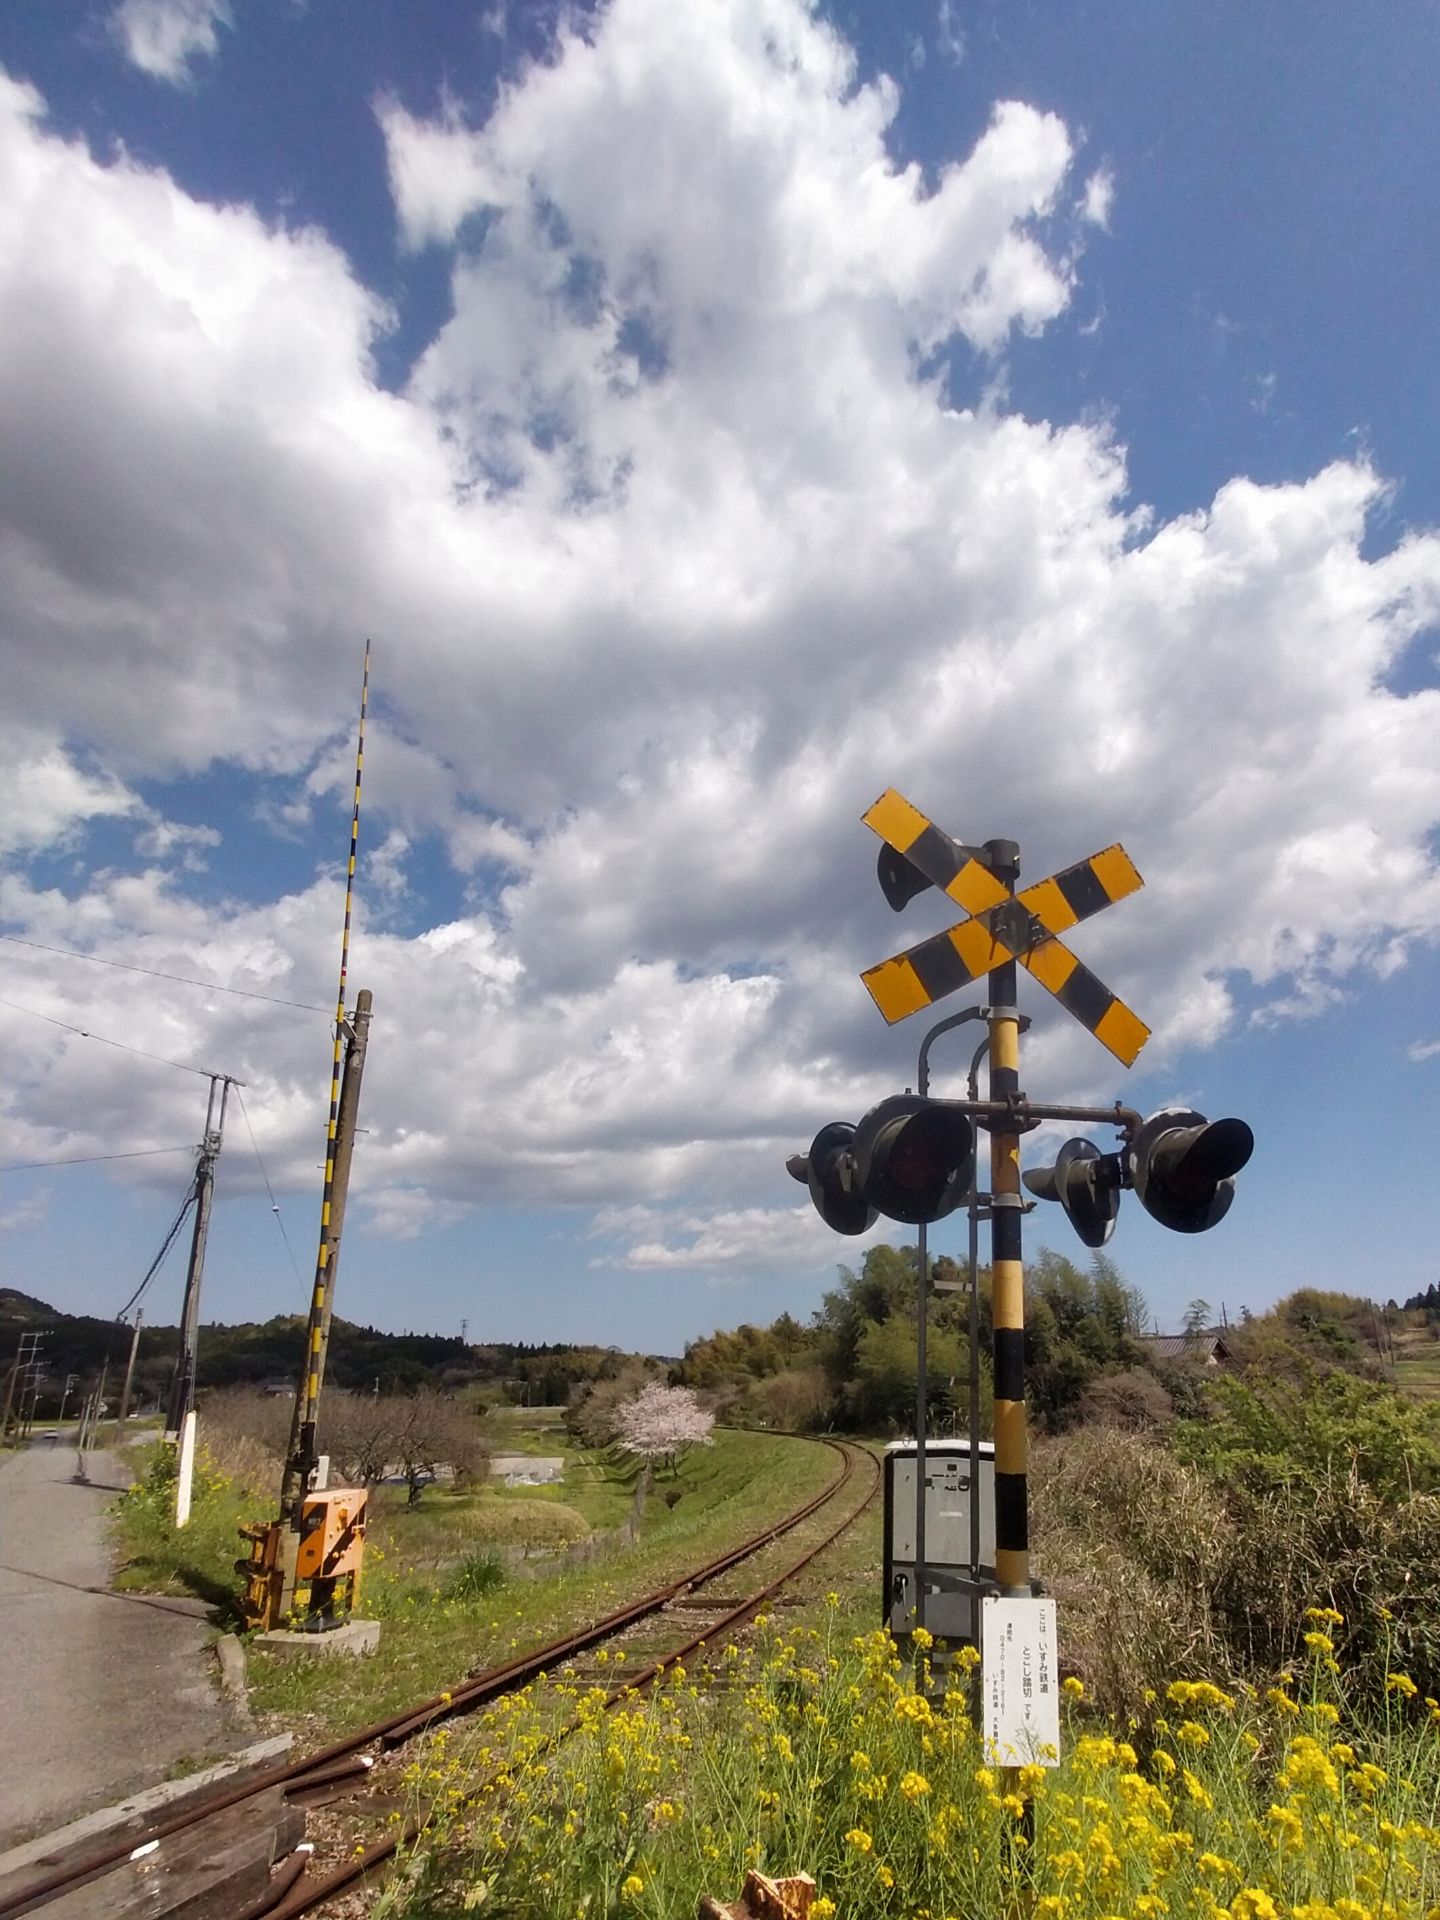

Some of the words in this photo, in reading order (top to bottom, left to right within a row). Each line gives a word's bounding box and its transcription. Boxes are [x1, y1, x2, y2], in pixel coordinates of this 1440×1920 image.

[1039, 1642, 1048, 1693] いすみ鉄道
[1024, 1704, 1031, 1720] です
